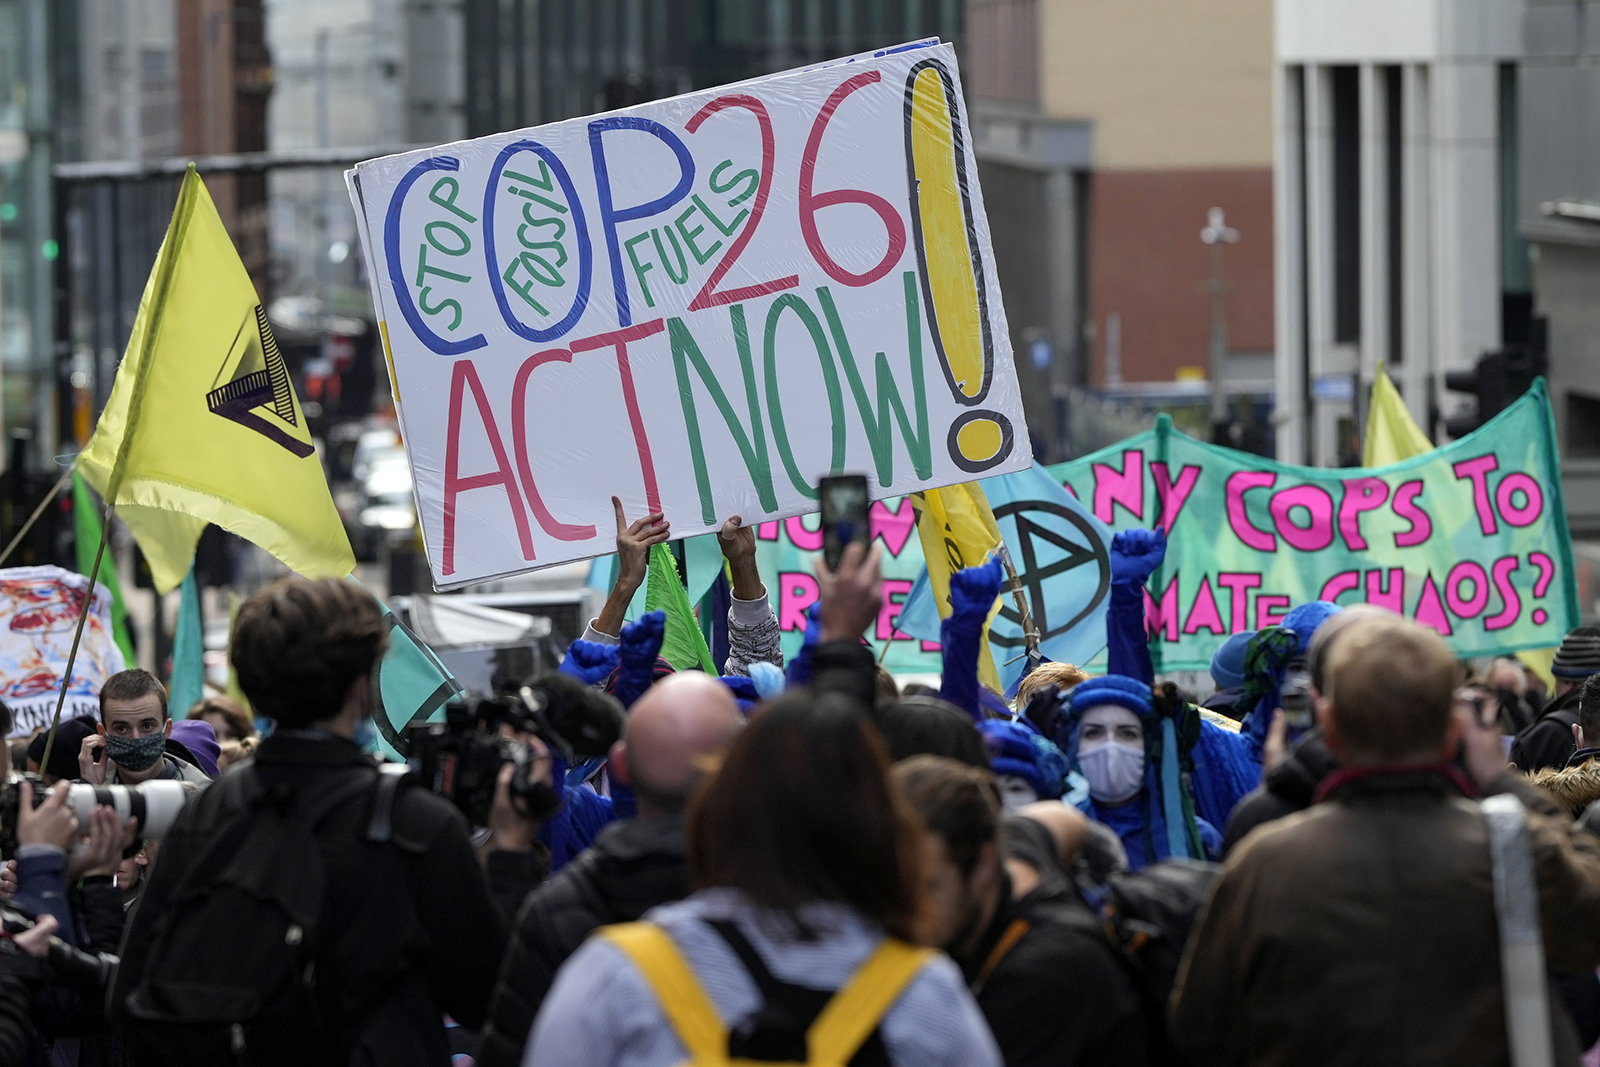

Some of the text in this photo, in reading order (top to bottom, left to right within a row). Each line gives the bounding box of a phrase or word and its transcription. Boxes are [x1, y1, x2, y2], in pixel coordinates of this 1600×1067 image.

[415, 176, 478, 332] STOP
[623, 158, 760, 308] FUELS
[441, 317, 666, 576] ACT
[1064, 448, 1543, 552] NY COPS TO
[1141, 569, 1291, 643] MATE
